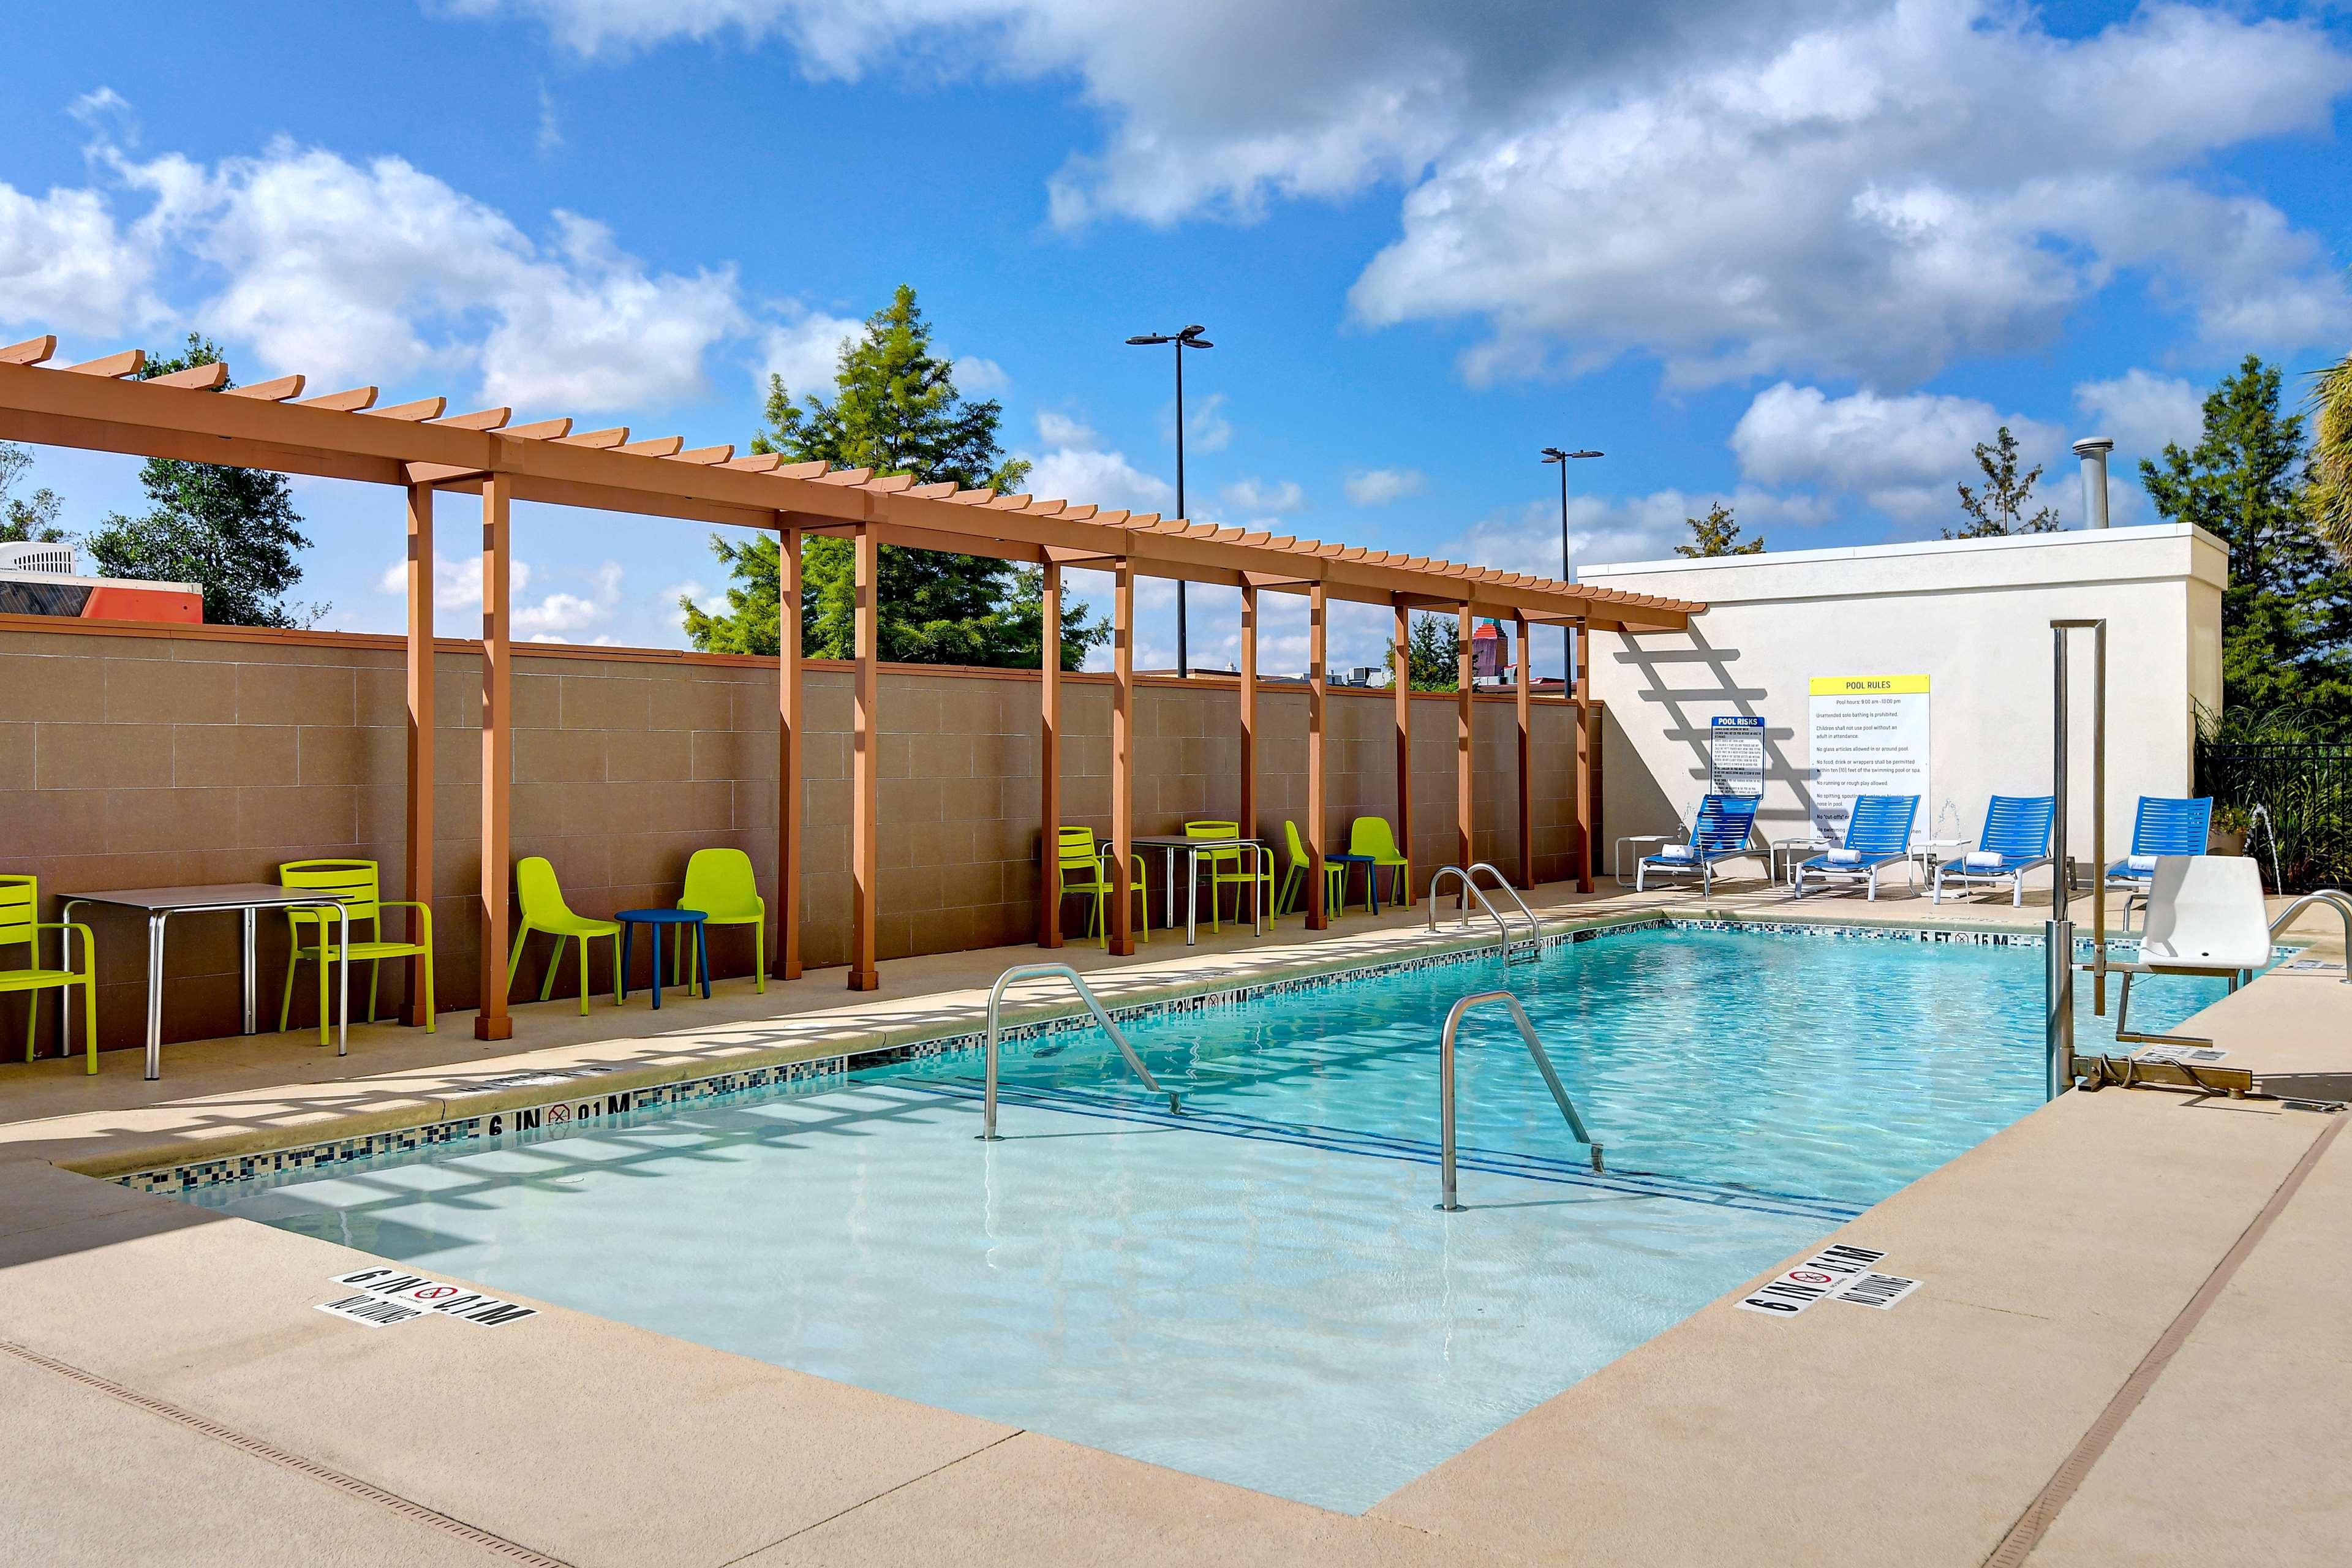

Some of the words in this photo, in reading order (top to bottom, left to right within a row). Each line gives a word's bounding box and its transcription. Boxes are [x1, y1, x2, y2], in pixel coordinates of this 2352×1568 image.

[1935, 932, 1951, 943] FT
[1993, 935, 2008, 945] M
[1192, 996, 1205, 1011] FT
[1236, 989, 1247, 1003] M
[489, 1115, 502, 1136] 6
[516, 1108, 540, 1132] IN
[608, 1093, 630, 1115] M
[1822, 1244, 1886, 1262] M
[342, 1270, 393, 1283] 6
[365, 1276, 433, 1294] IN
[1850, 1274, 1913, 1297] DIVING
[1761, 1281, 1826, 1301] IN
[1836, 1292, 1887, 1306] NO
[324, 1294, 376, 1309] NO
[1745, 1298, 1799, 1312] 6
[345, 1301, 422, 1324] DIVING
[465, 1304, 537, 1325] M
